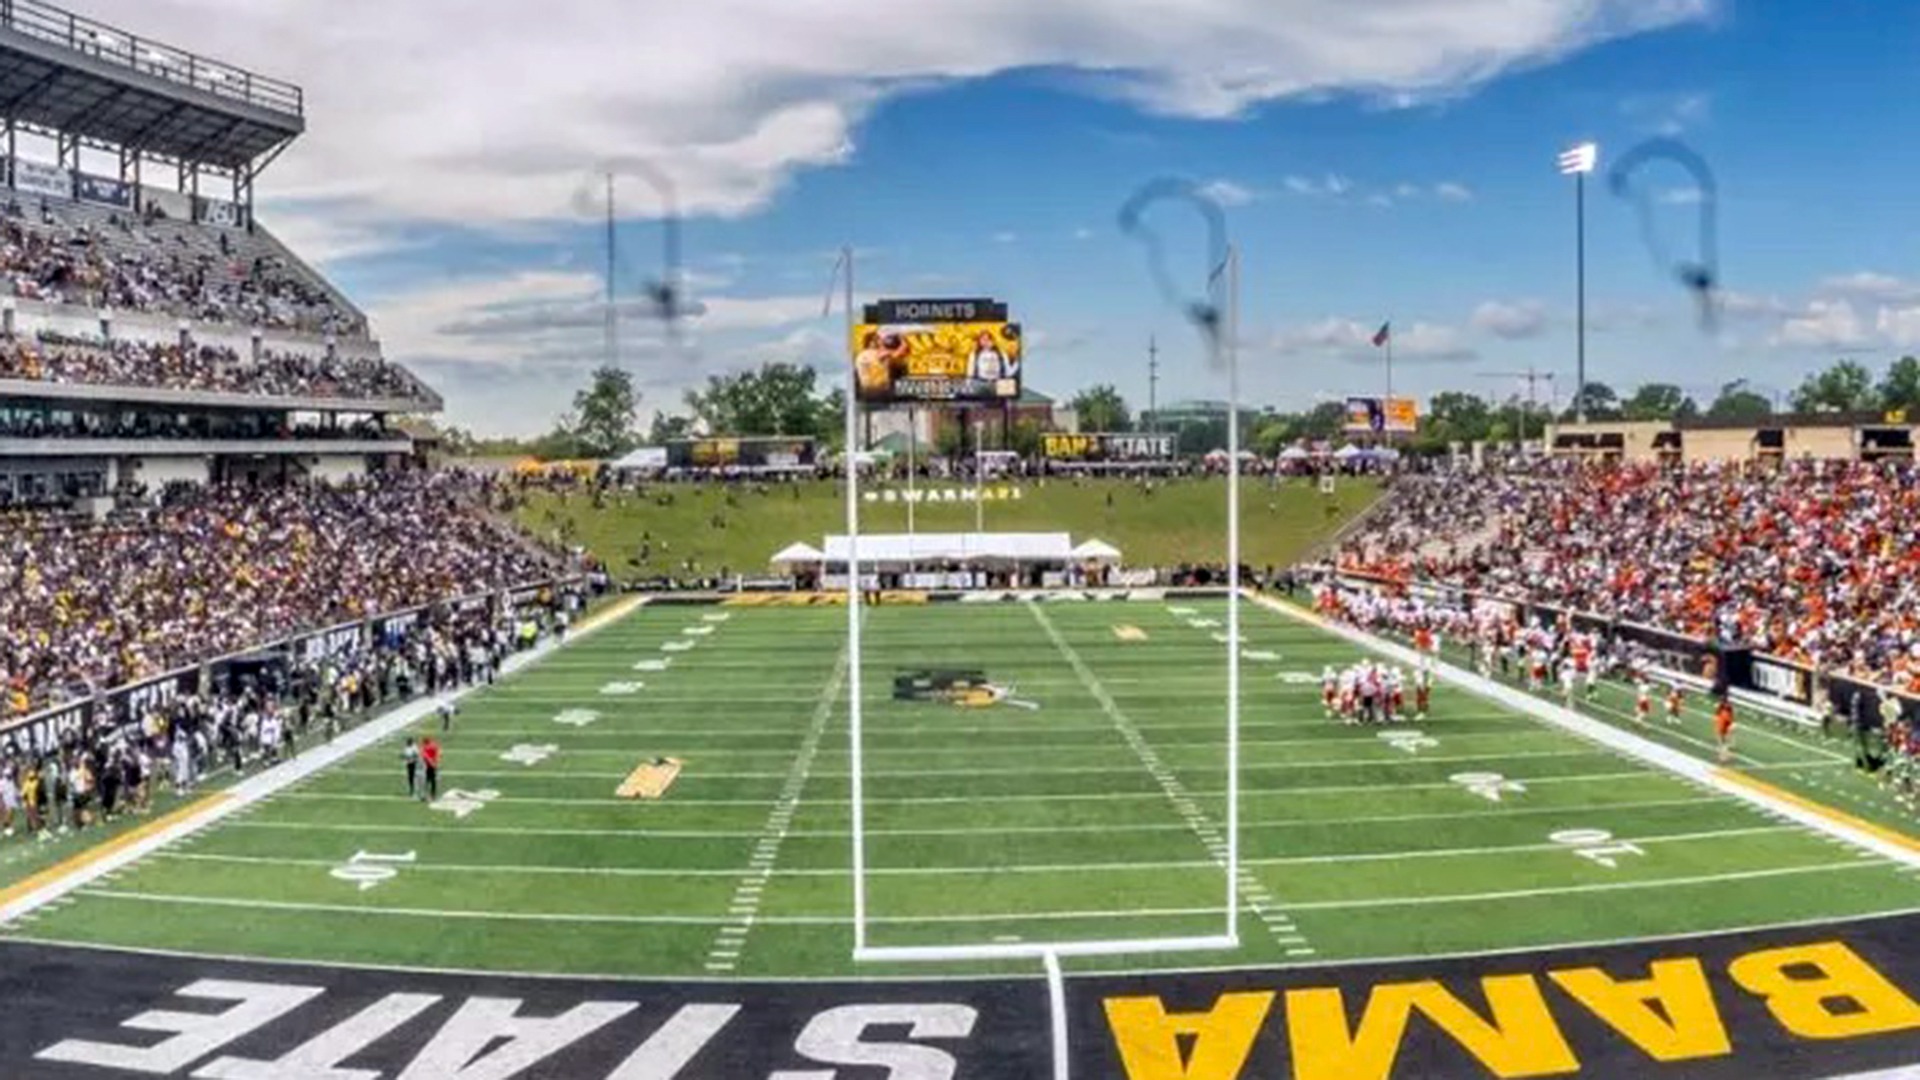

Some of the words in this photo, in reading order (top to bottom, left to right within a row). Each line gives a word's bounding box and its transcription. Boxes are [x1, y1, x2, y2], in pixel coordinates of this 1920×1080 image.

[895, 303, 976, 319] HORNETS
[34, 979, 978, 1080] STATE
[1103, 941, 1920, 1080] BAMA
